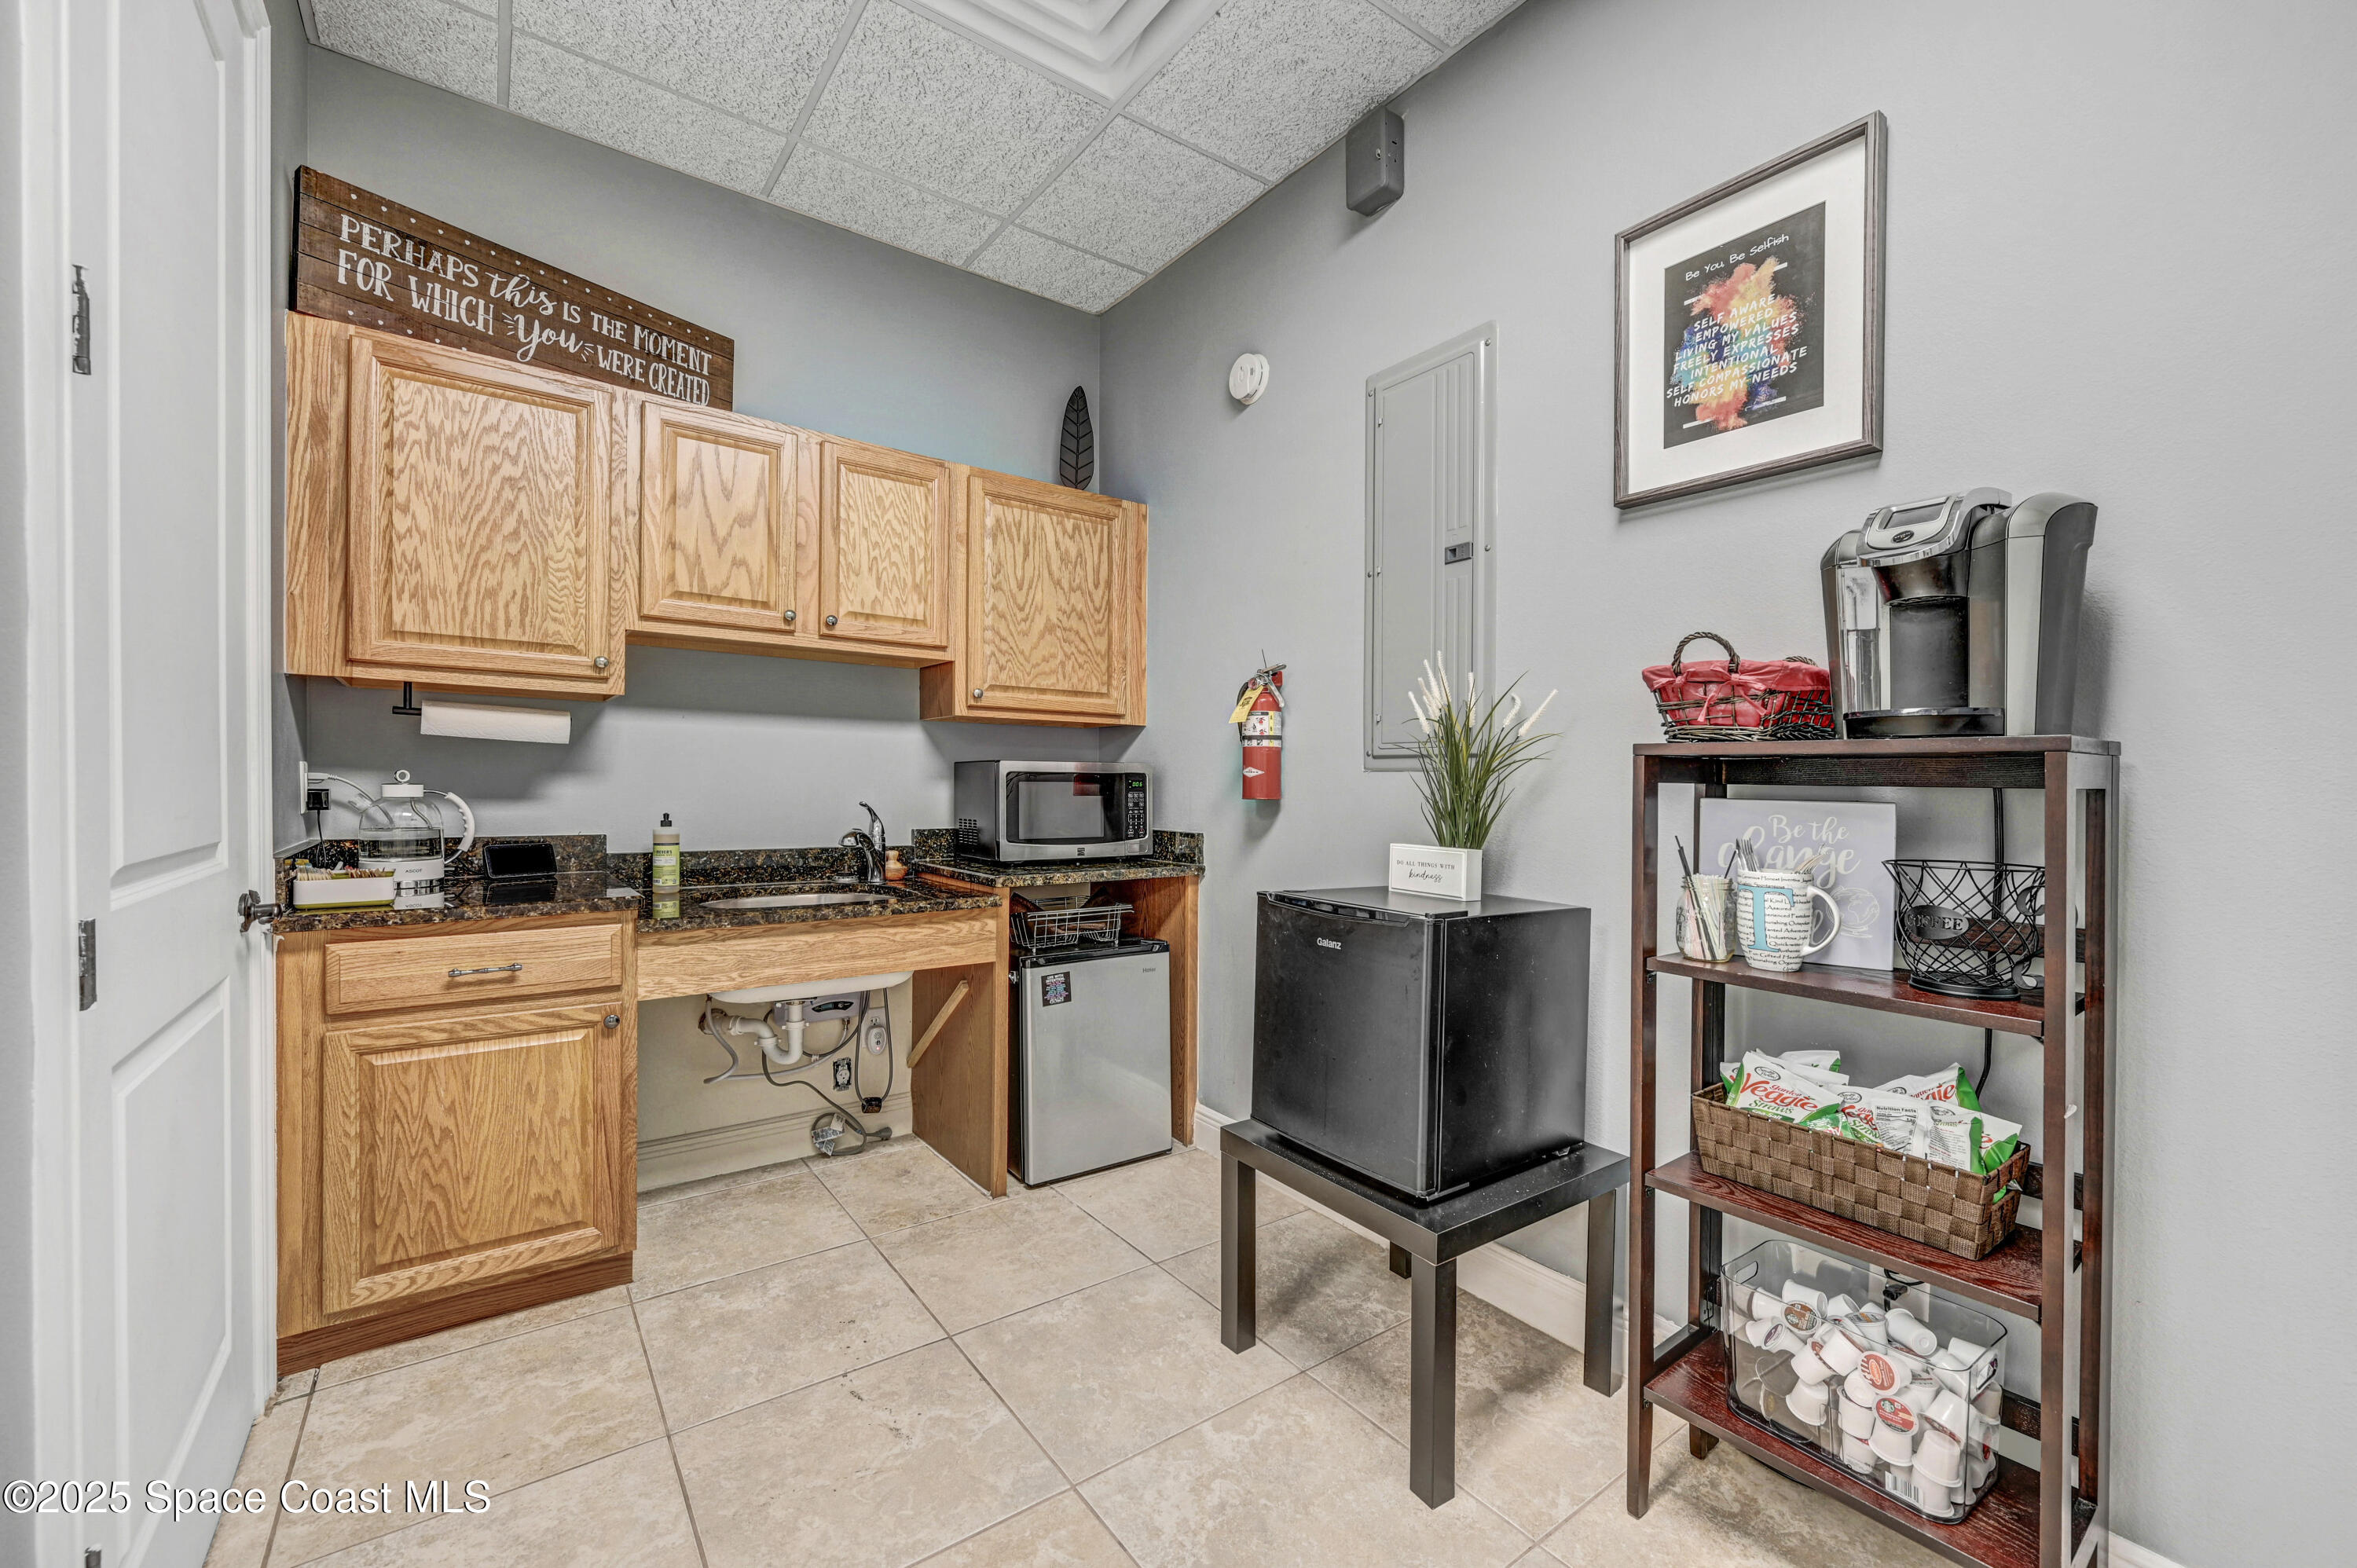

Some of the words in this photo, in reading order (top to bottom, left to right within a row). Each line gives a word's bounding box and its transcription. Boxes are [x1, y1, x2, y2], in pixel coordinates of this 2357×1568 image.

[1685, 269, 1700, 281] Be
[1729, 253, 1746, 264] Be
[339, 214, 479, 288] PERHAPS
[485, 273, 558, 316] this
[563, 301, 581, 324] IS
[590, 311, 628, 343] THE
[633, 324, 713, 376] MOMENT
[1694, 312, 1725, 332] SELF
[1729, 293, 1776, 318] AWARE
[337, 248, 394, 302] FOR
[408, 275, 495, 335] WHICH
[513, 313, 584, 362] You
[596, 344, 646, 383] WERE
[648, 361, 711, 407] CREATED
[1675, 340, 1718, 361] LIVING
[1722, 331, 1740, 346] MY
[1744, 311, 1798, 338] VALUES
[1695, 307, 1774, 343] EMPOWERED
[1673, 350, 1718, 374] FREELY
[1723, 323, 1800, 358] EXPRESSES
[1691, 344, 1779, 379] INTENTIONAL
[1666, 381, 1695, 399] SELF
[1699, 346, 1808, 388] COMPASSIONATE
[1673, 384, 1725, 408] HONORS
[1729, 377, 1747, 391] MY
[1751, 361, 1798, 384] NEEDS
[1768, 814, 1806, 844] Be
[1808, 816, 1849, 844] the
[1409, 868, 1442, 883] kindness
[1738, 885, 1794, 952] T
[1906, 914, 1963, 931] COFFEE
[1317, 937, 1342, 950] Galanz
[1740, 1073, 1818, 1112] Veggie
[1749, 1100, 1794, 1114] Straws
